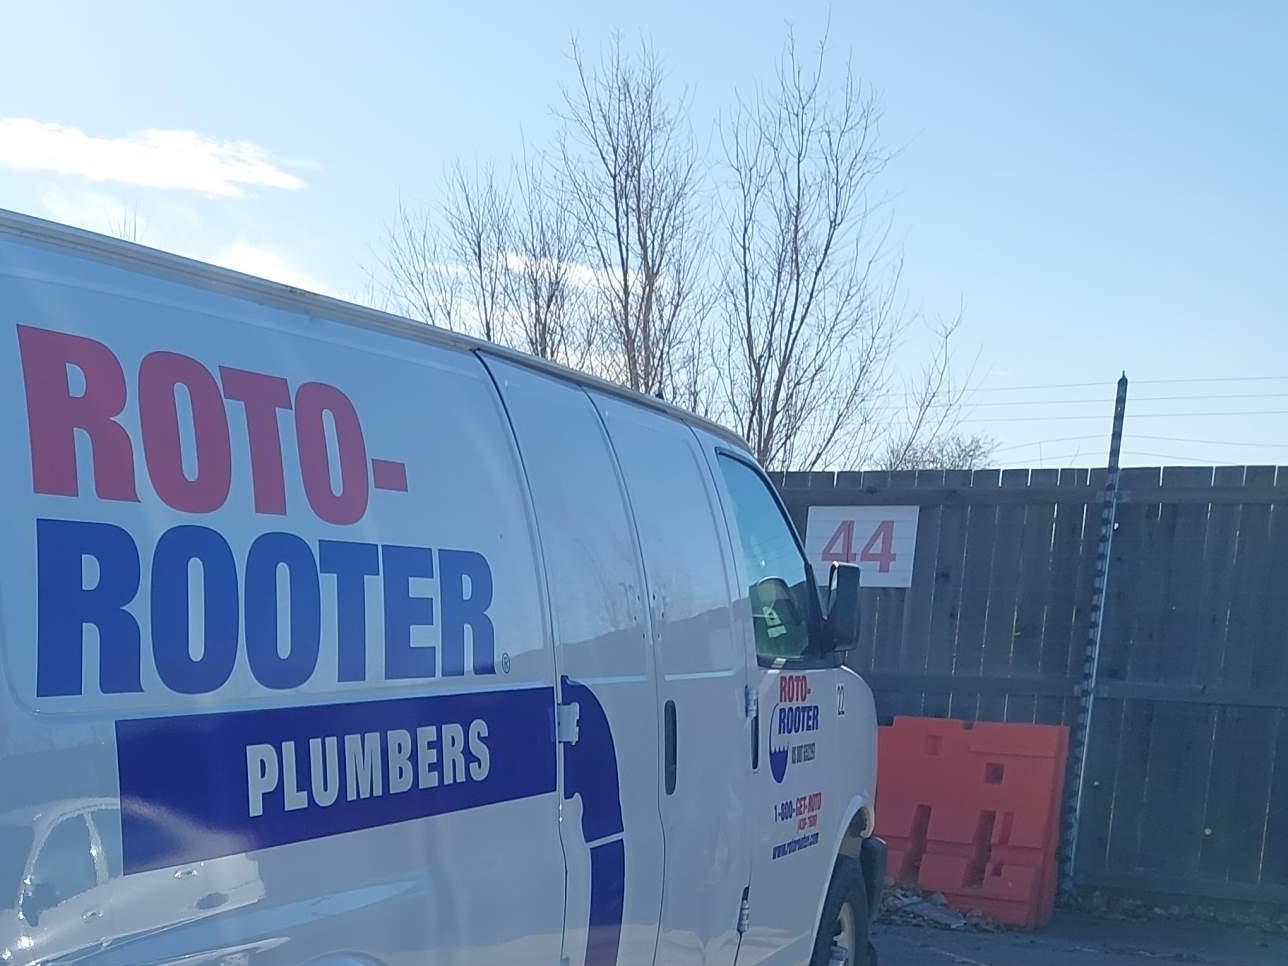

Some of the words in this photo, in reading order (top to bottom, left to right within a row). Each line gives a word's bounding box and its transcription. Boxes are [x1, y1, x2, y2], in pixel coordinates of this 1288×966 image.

[16, 323, 409, 526] ROTO-
[821, 519, 897, 573] 44
[36, 518, 497, 698] ROOTER
[777, 705, 820, 736] ROOTER
[779, 675, 812, 703] ROTO-
[245, 719, 491, 817] PLUMBERS
